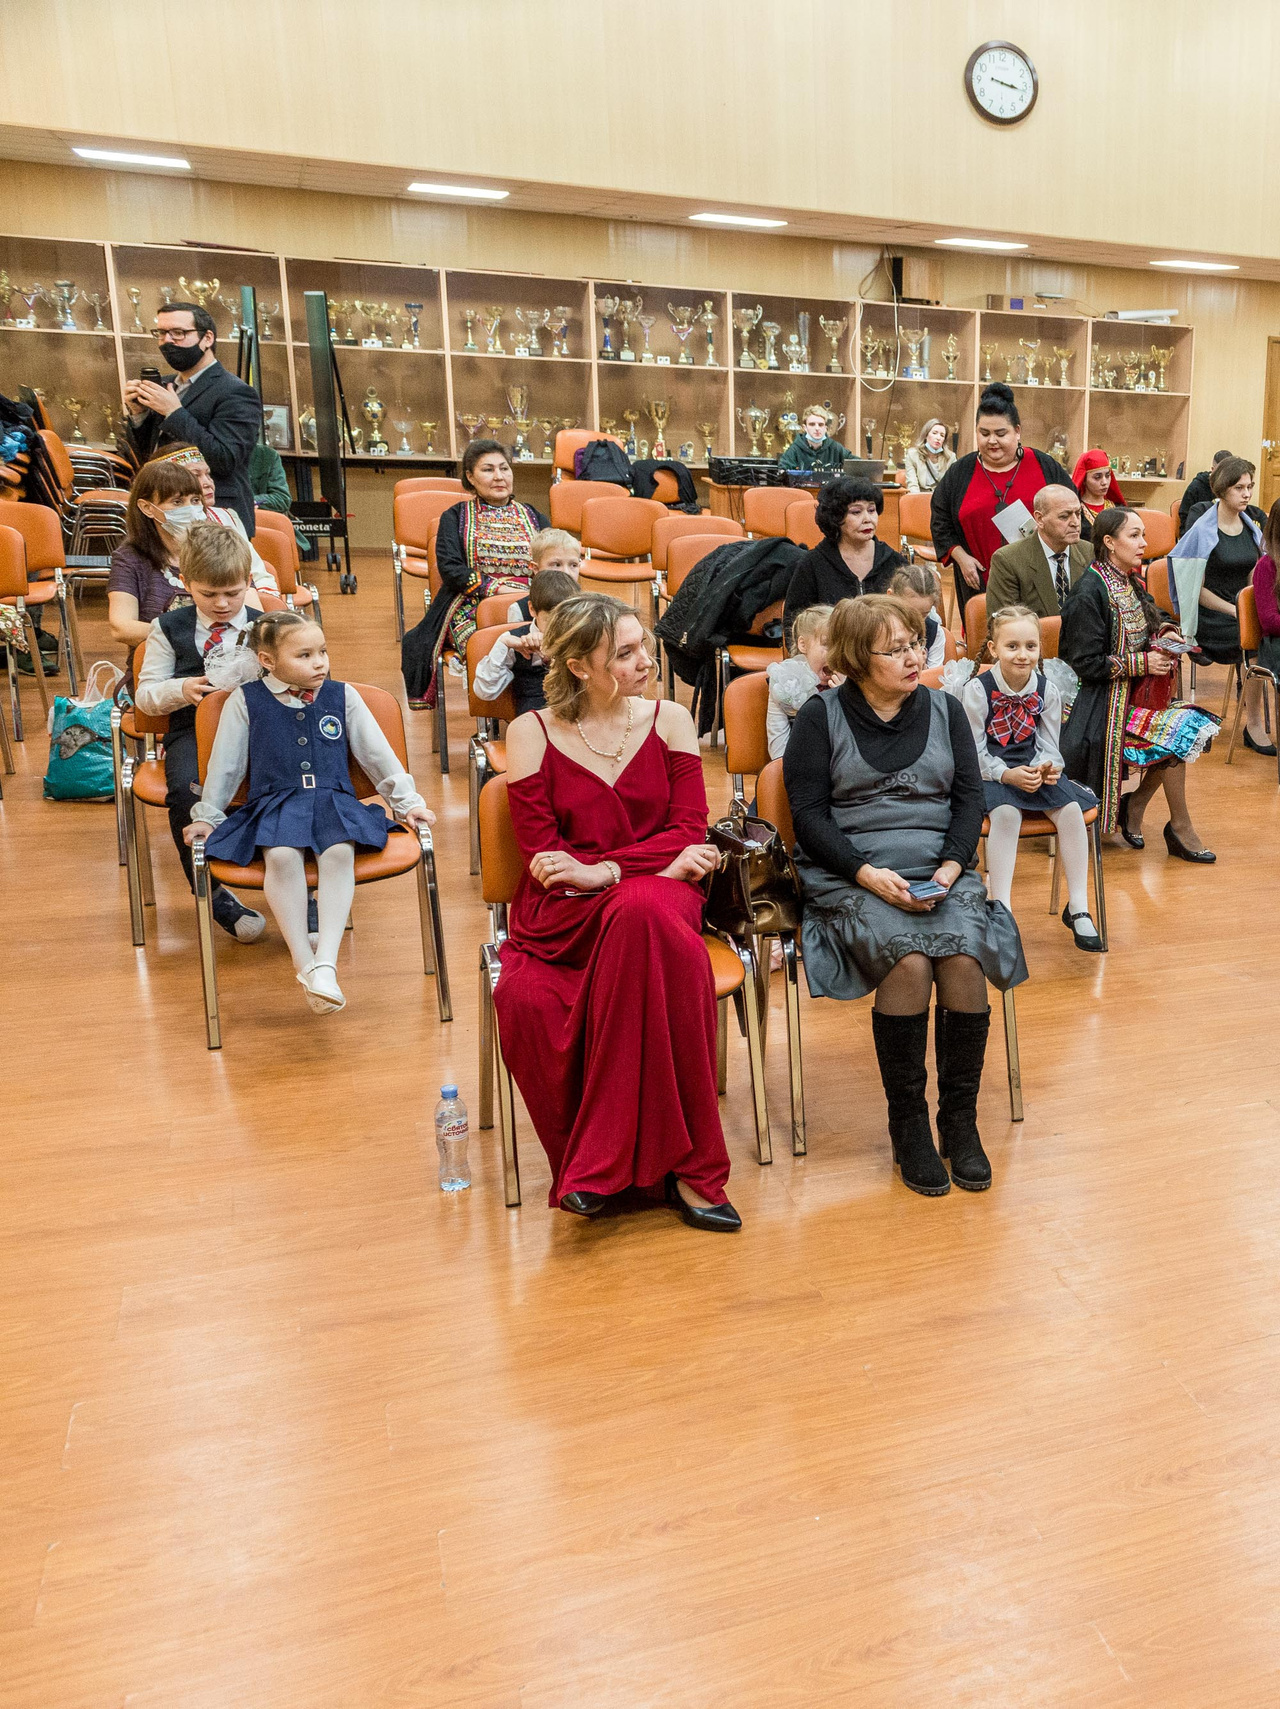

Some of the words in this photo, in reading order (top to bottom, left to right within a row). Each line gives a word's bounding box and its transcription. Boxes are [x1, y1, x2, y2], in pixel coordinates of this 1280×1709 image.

[988, 54, 995, 64] 11
[999, 52, 1007, 63] 12
[980, 62, 987, 73] 10
